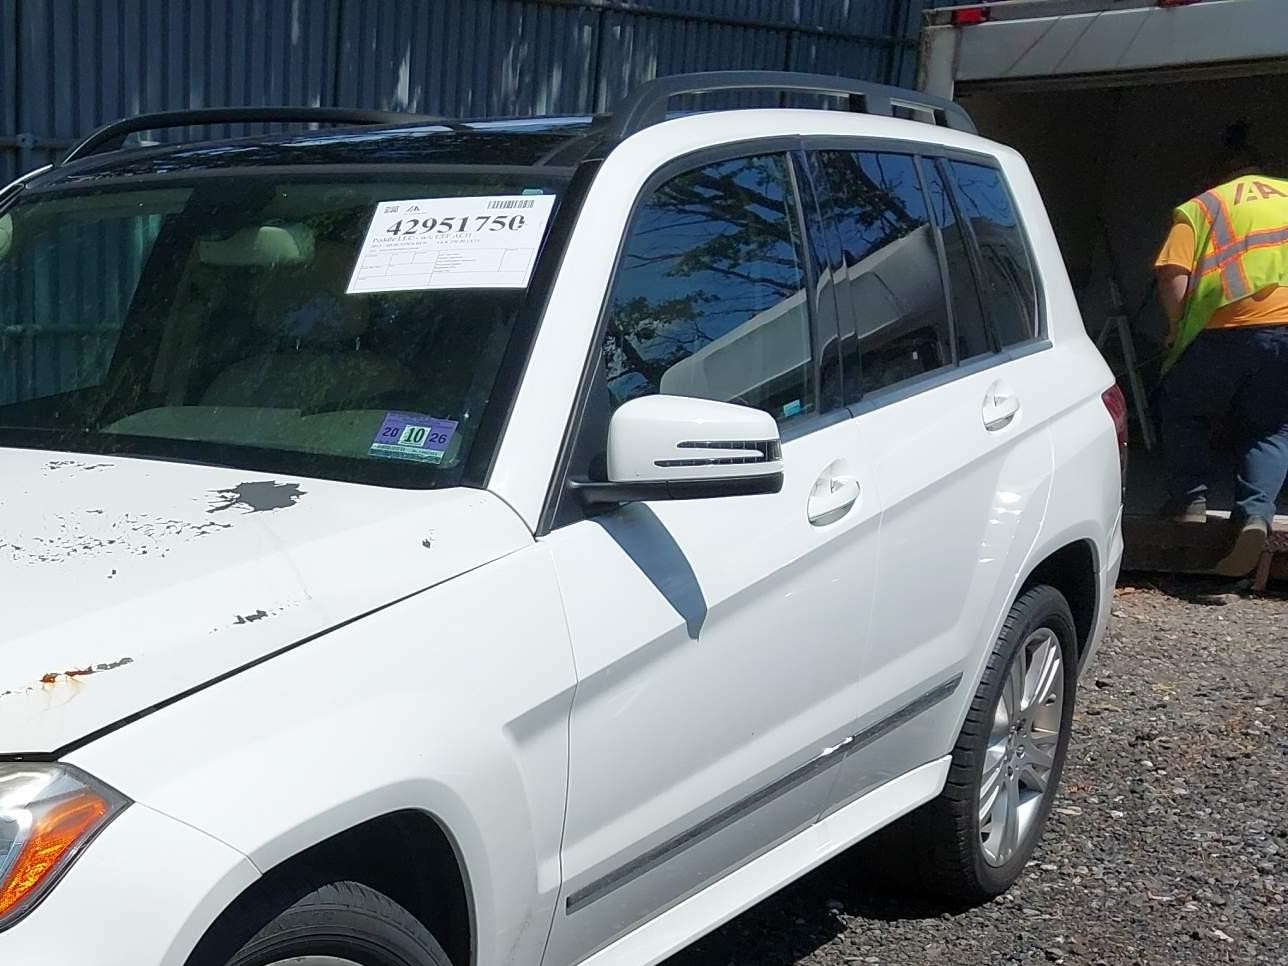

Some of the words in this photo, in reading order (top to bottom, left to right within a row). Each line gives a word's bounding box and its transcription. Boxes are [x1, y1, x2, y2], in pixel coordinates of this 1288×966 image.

[386, 214, 525, 236] 42951750
[382, 426, 400, 438] 20
[404, 427, 426, 443] 10
[429, 432, 448, 444] 26
